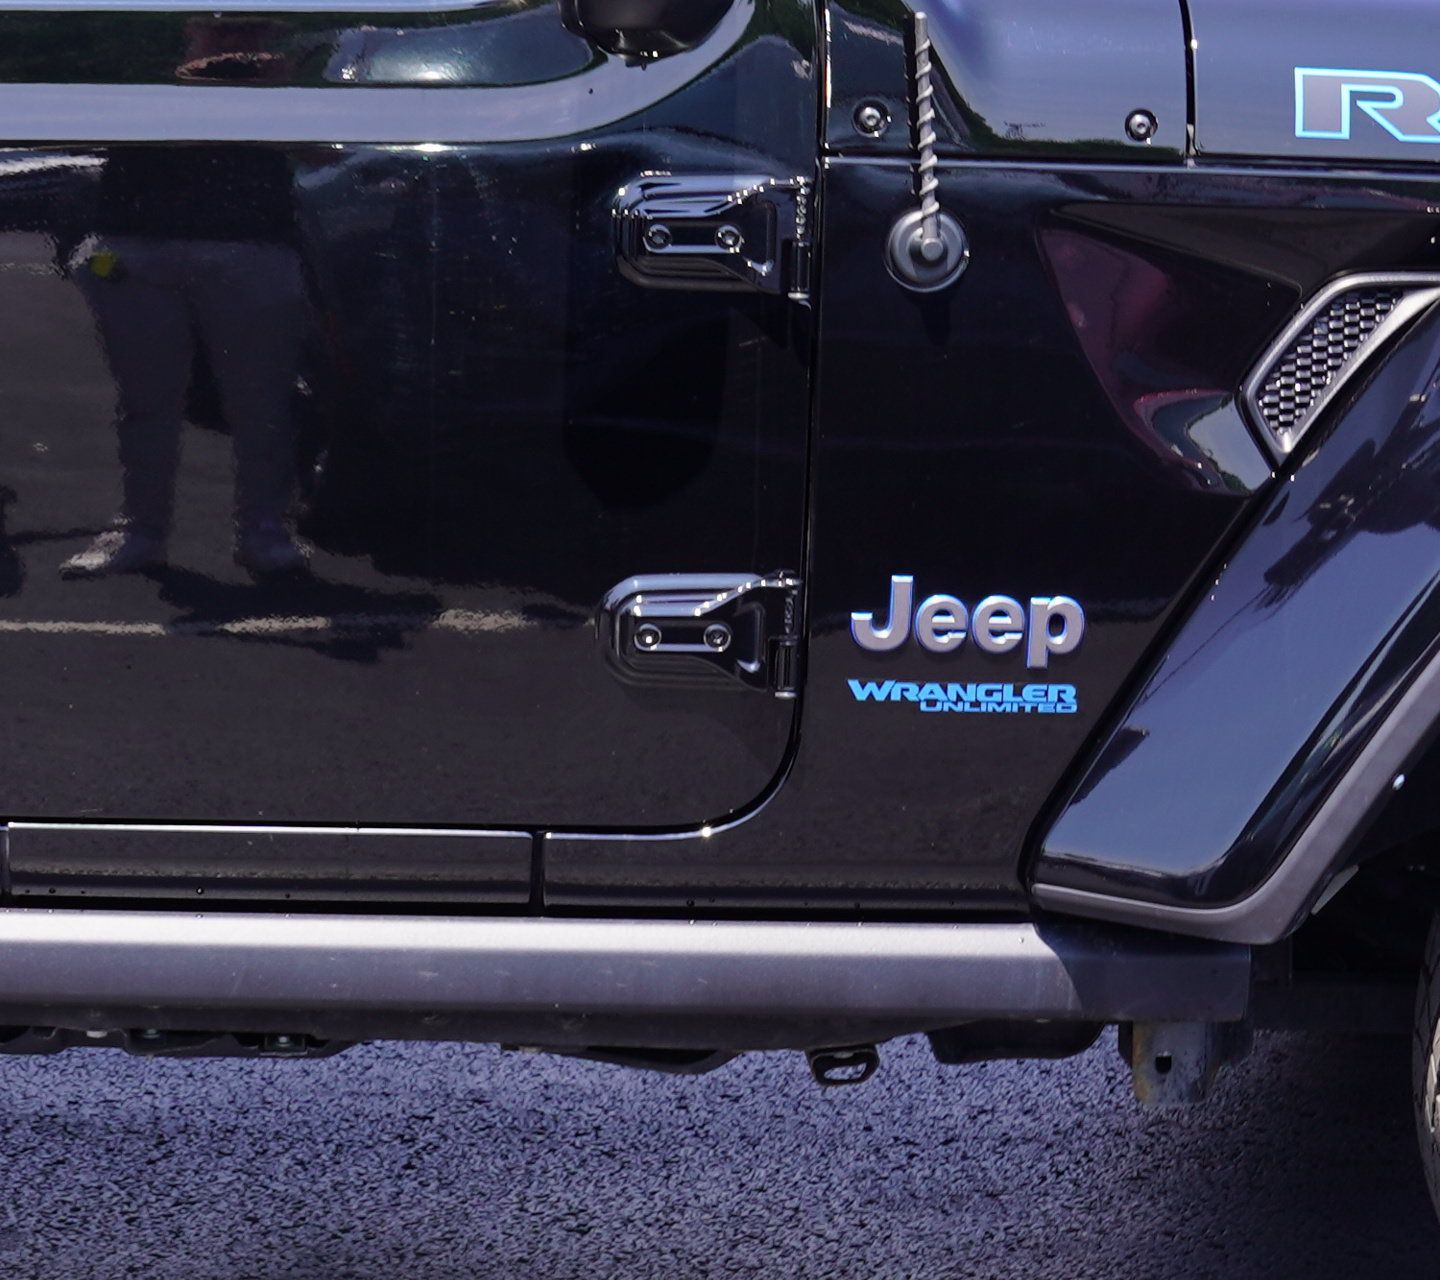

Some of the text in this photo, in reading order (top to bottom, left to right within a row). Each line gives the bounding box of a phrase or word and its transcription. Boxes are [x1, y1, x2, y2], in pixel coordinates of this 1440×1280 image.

[850, 575, 1085, 669] Jeep
[847, 679, 1077, 703] WRANGLER
[920, 701, 1077, 713] UNLIMITED
